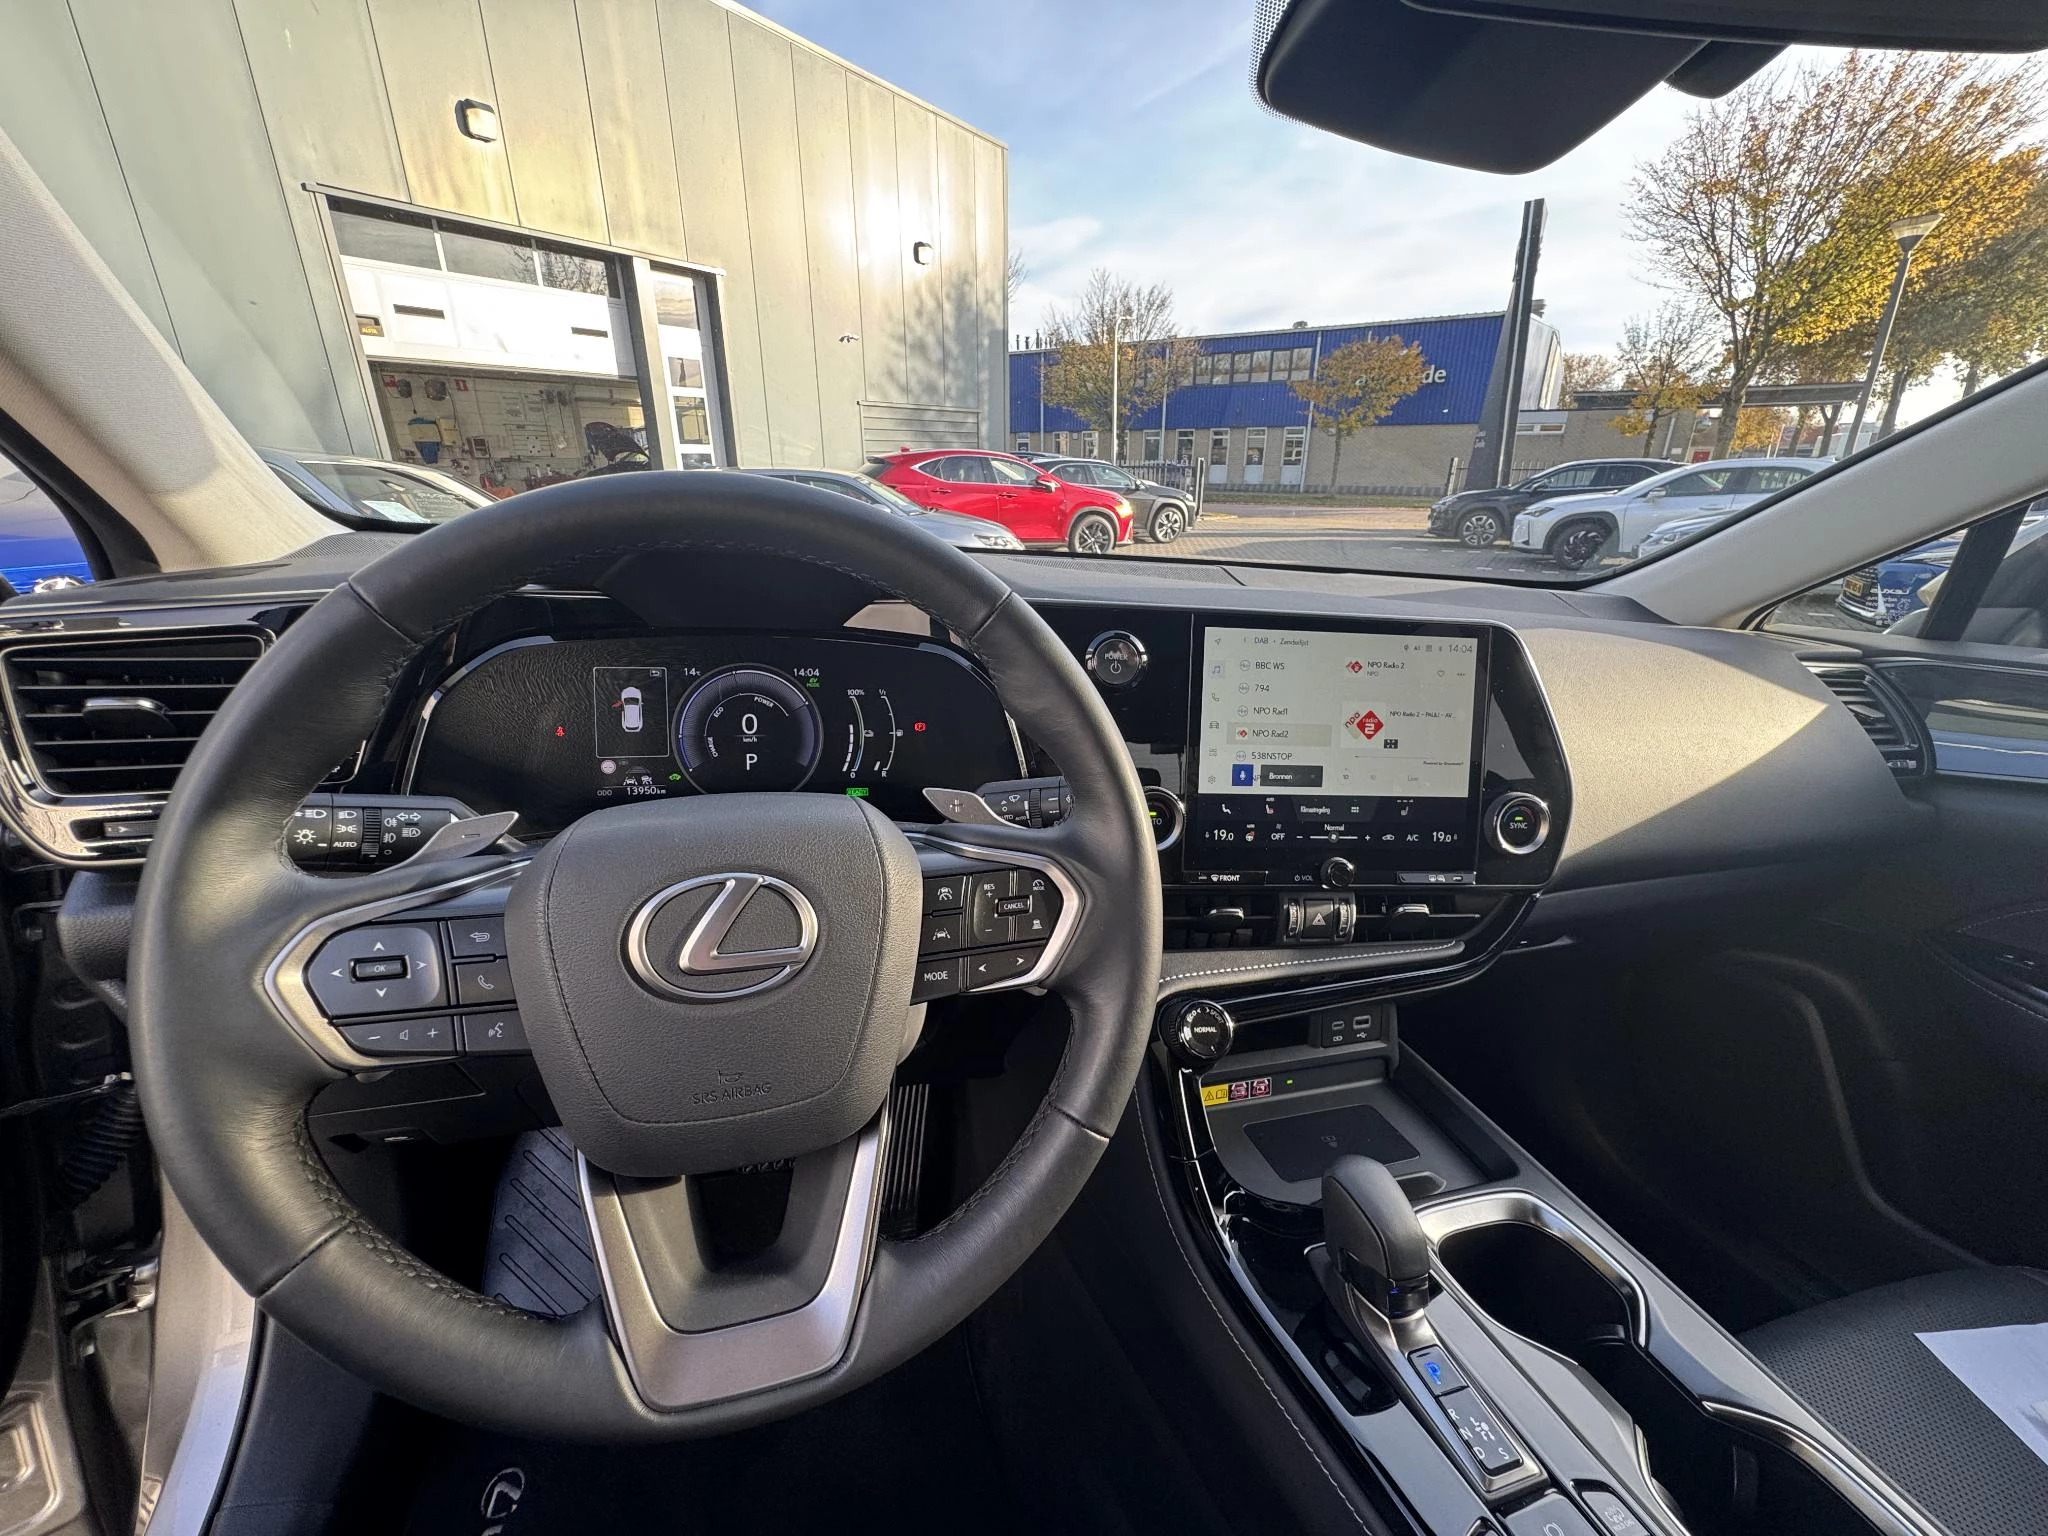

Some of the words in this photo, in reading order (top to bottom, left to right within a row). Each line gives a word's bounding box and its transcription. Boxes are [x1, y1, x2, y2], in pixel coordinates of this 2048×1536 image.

[1104, 652, 1129, 661] POWER
[1255, 662, 1271, 670] BBC
[1367, 661, 1382, 669] NPO
[1383, 662, 1399, 670] Radio
[1400, 662, 1405, 670] 2
[793, 667, 820, 677] 14:04
[1254, 684, 1270, 692] 794
[713, 706, 724, 718] ECO
[1253, 707, 1271, 715] NPO
[741, 713, 758, 735] 0
[1252, 729, 1269, 738] NPO
[1271, 730, 1289, 738] Rad2
[1251, 751, 1293, 760] 538NSTOP
[746, 753, 758, 771] P
[1268, 771, 1293, 780] Bronnen
[596, 789, 613, 797] ODO
[626, 786, 656, 796] 13950
[1324, 823, 1345, 831] Normal
[1509, 822, 1528, 830] SYNC
[1270, 832, 1285, 841] OFF
[1406, 834, 1420, 842] A/C
[1219, 874, 1241, 882] FRONT
[983, 883, 996, 891] RES
[1003, 901, 1025, 910] CANCEL
[373, 965, 386, 973] OK
[924, 970, 949, 982] MODE
[1186, 1010, 1197, 1022] ECO
[692, 1090, 719, 1106] SRS
[720, 1082, 772, 1102] AIRBAG
[1424, 1361, 1442, 1385] P
[1447, 1408, 1460, 1420] R
[1459, 1426, 1473, 1440] N
[1473, 1446, 1486, 1460] D
[1498, 1447, 1509, 1460] S
